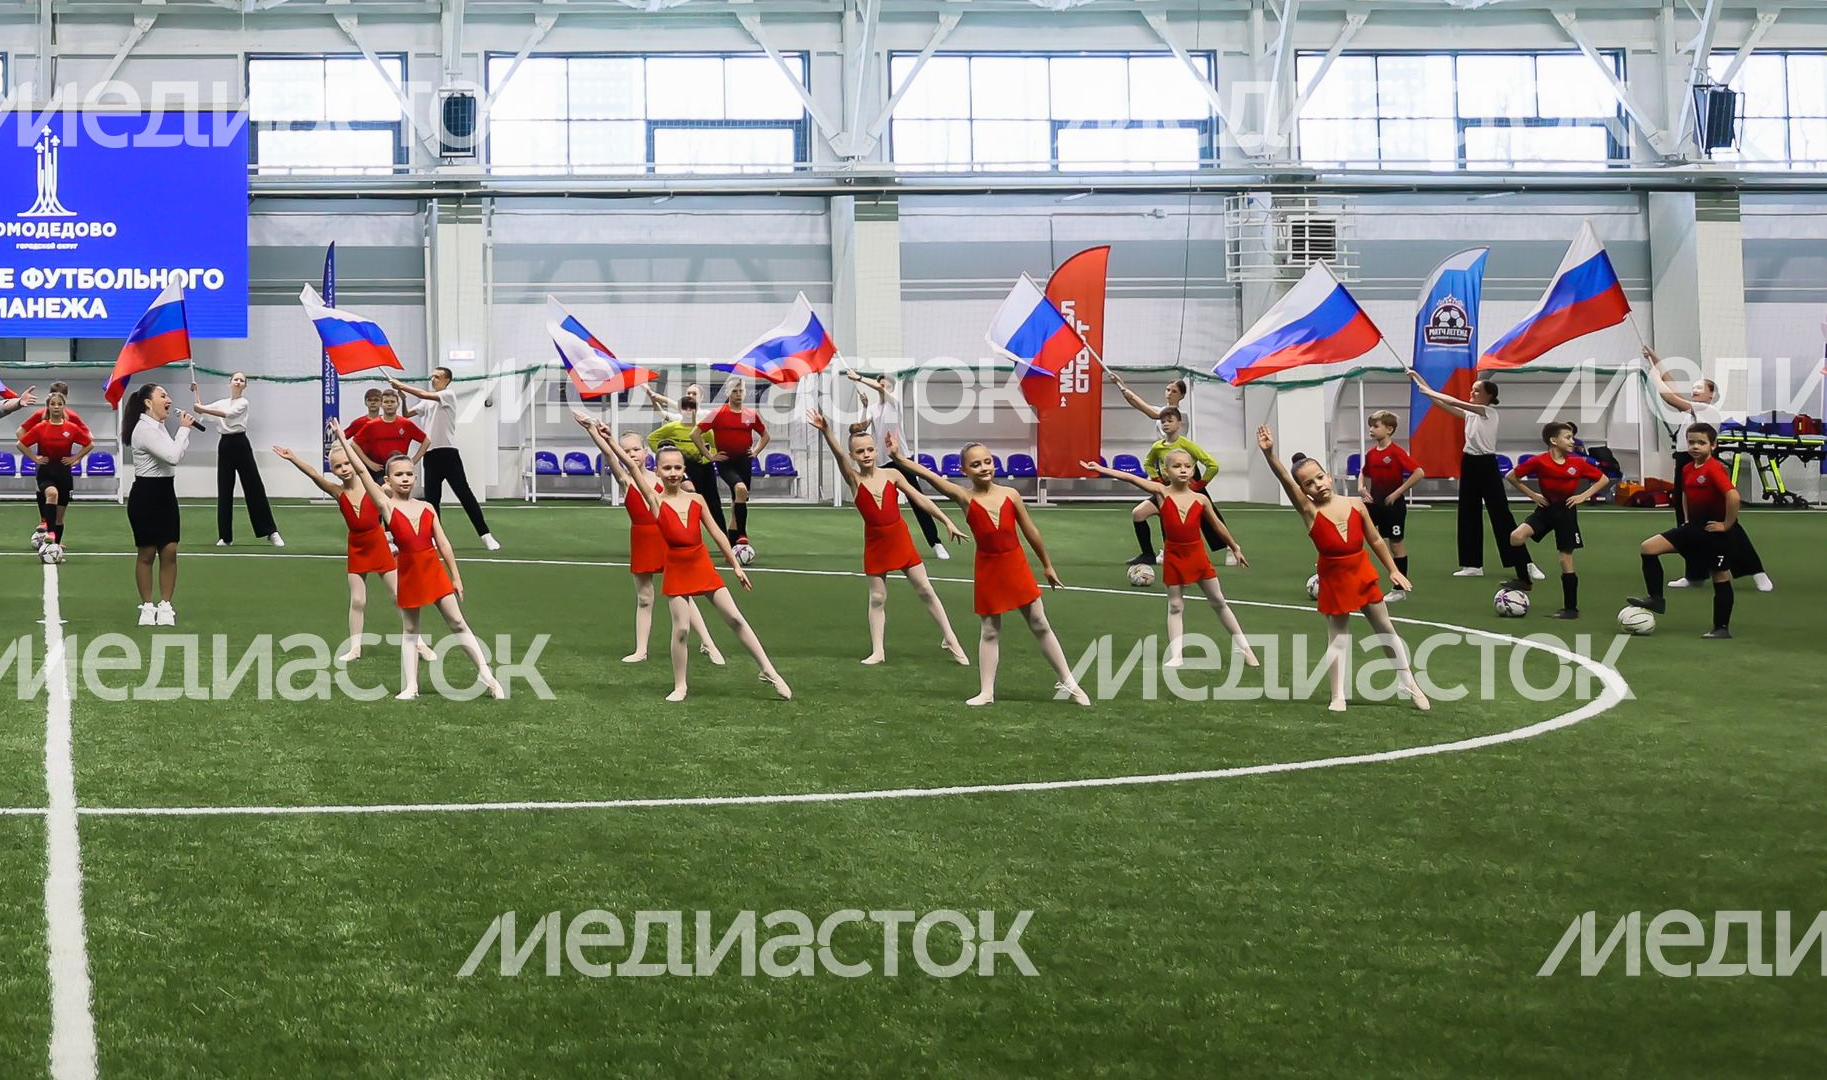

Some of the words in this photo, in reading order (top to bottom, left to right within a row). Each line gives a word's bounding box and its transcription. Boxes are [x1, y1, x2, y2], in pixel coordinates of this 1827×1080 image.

[20, 267, 225, 291] ФУТБОЛЬНОГО
[1392, 525, 1401, 536] 8
[1717, 555, 1724, 567] 7
